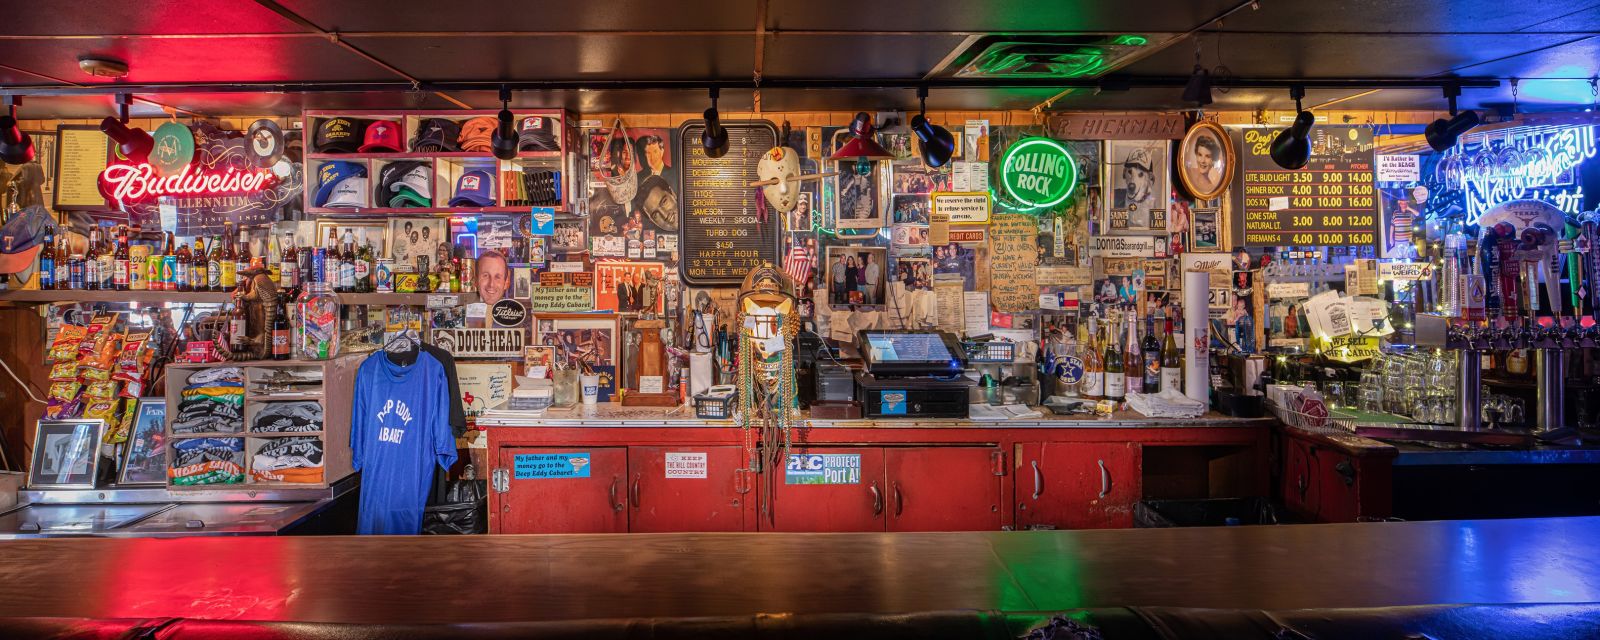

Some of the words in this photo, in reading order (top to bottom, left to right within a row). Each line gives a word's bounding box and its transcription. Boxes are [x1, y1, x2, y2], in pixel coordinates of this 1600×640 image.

[1056, 119, 1072, 135] R.
[1081, 118, 1179, 135] HICKMAN
[1006, 152, 1066, 179] ROLLING
[104, 163, 273, 200] Budweiser
[1245, 174, 1259, 183] LITE,
[1260, 174, 1273, 182] BUD
[1274, 174, 1291, 182] LIGHT
[1293, 172, 1313, 183] 3.50
[1322, 172, 1343, 183] 9.00
[1348, 172, 1373, 183] 14.00
[1017, 174, 1052, 197] ROCK
[1245, 186, 1267, 194] SHINER
[1267, 186, 1284, 194] BOCK
[1292, 185, 1312, 195] 4.00
[1318, 185, 1343, 195] 10.00
[1348, 185, 1373, 195] 16.00
[693, 190, 713, 198] TITOS
[1245, 198, 1258, 207] DOS
[1292, 197, 1313, 207] 4.00
[1318, 197, 1343, 207] 10.00
[1348, 197, 1373, 207] 16.00
[692, 208, 723, 216] JAMESON
[742, 208, 748, 216] 8
[1110, 211, 1129, 219] SAINTS
[1153, 211, 1164, 219] YES
[1246, 212, 1262, 220] LONE
[1262, 212, 1277, 220] STAR
[198, 215, 230, 223] SINCE
[1293, 216, 1313, 226] 3.00
[1322, 216, 1343, 226] 8.00
[1348, 216, 1373, 226] 12.00
[949, 232, 965, 240] REDIT
[965, 232, 983, 240] CARDS
[1246, 234, 1276, 242] FIREMANS
[1276, 234, 1281, 242] 4
[1292, 234, 1313, 243] 4.00
[1318, 234, 1343, 243] 10.00
[1348, 234, 1373, 243] 16.00
[699, 250, 727, 258] HAPPY
[734, 250, 759, 258] HOUR
[692, 259, 700, 267] 12
[704, 259, 713, 267] TO
[749, 259, 759, 267] TO
[1194, 260, 1222, 270] Miller
[689, 268, 706, 276] MON
[712, 268, 726, 276] TUE
[732, 268, 748, 276] WED
[493, 305, 524, 317] Titleist
[457, 330, 522, 352] DOUG-HEAD
[1332, 337, 1345, 346] WE
[1347, 337, 1368, 345] SELL
[145, 406, 164, 416] Texas
[395, 399, 413, 426] EDDY
[824, 456, 860, 468] PROTECT
[824, 467, 847, 483] Port
[849, 467, 859, 483] A!
